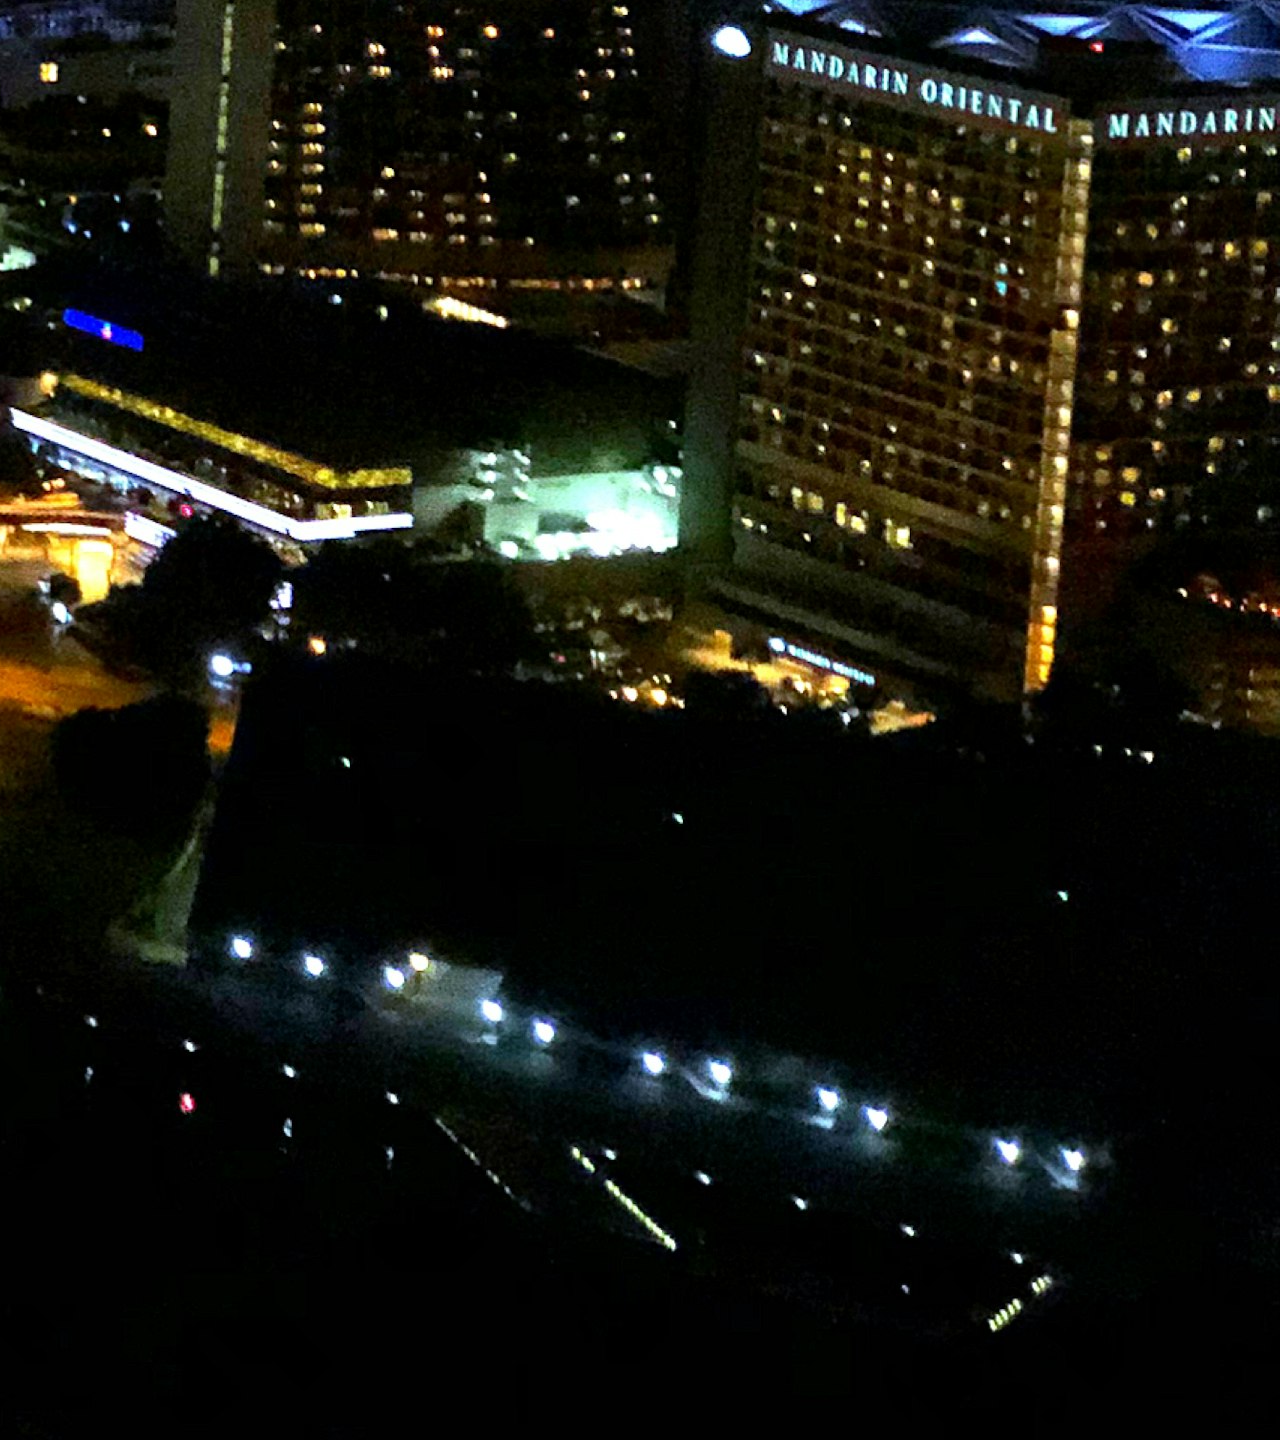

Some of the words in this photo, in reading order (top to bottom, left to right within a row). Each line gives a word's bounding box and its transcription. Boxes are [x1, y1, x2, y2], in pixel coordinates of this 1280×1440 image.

[772, 41, 910, 95] MANDARIN
[919, 78, 1058, 134] ORIENTAL
[1108, 107, 1277, 139] MANDARIN
